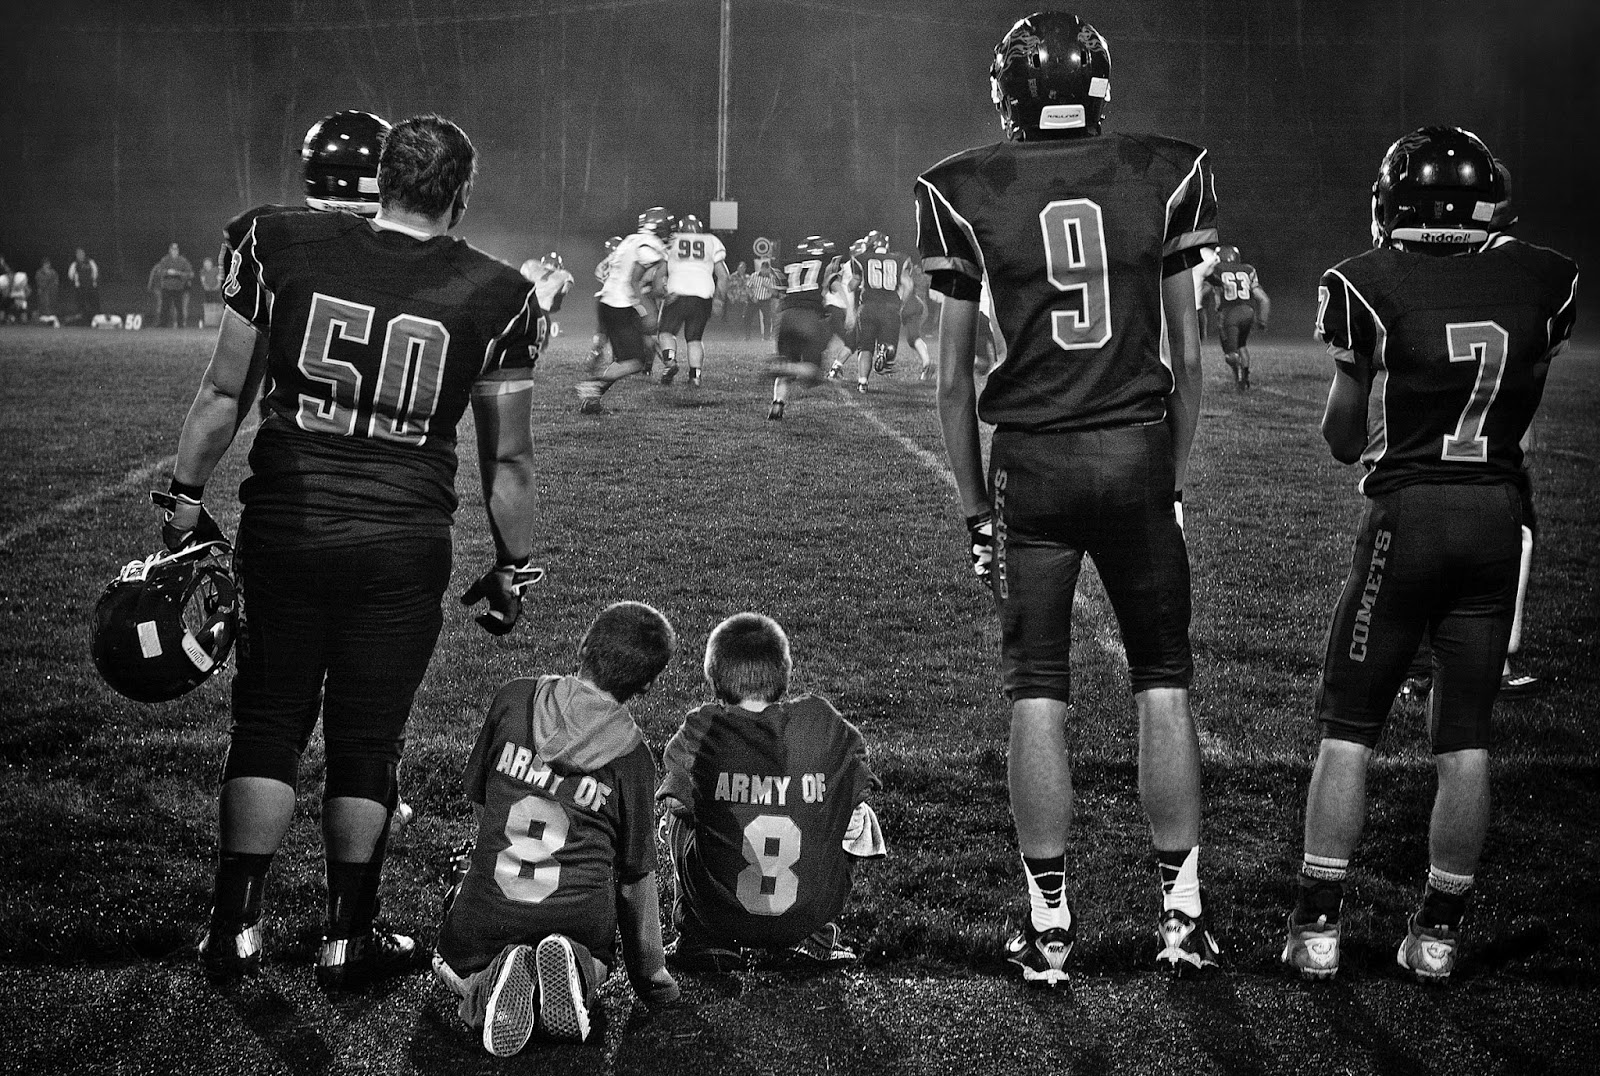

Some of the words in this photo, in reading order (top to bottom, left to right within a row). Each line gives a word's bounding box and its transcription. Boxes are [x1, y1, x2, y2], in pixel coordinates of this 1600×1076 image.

[678, 240, 705, 259] 99
[1039, 198, 1112, 350] 9
[124, 313, 143, 331] 50
[296, 292, 450, 446] 50
[1441, 320, 1509, 462] 7
[1349, 529, 1392, 662] COMETS
[496, 741, 564, 796] ARMY
[573, 775, 612, 812] OF
[714, 772, 791, 806] ARMY
[802, 773, 826, 804] OF
[494, 795, 571, 903] 8
[736, 814, 802, 917] 8
[1048, 945, 1064, 953] NIKE
[1165, 924, 1182, 933] NIKE
